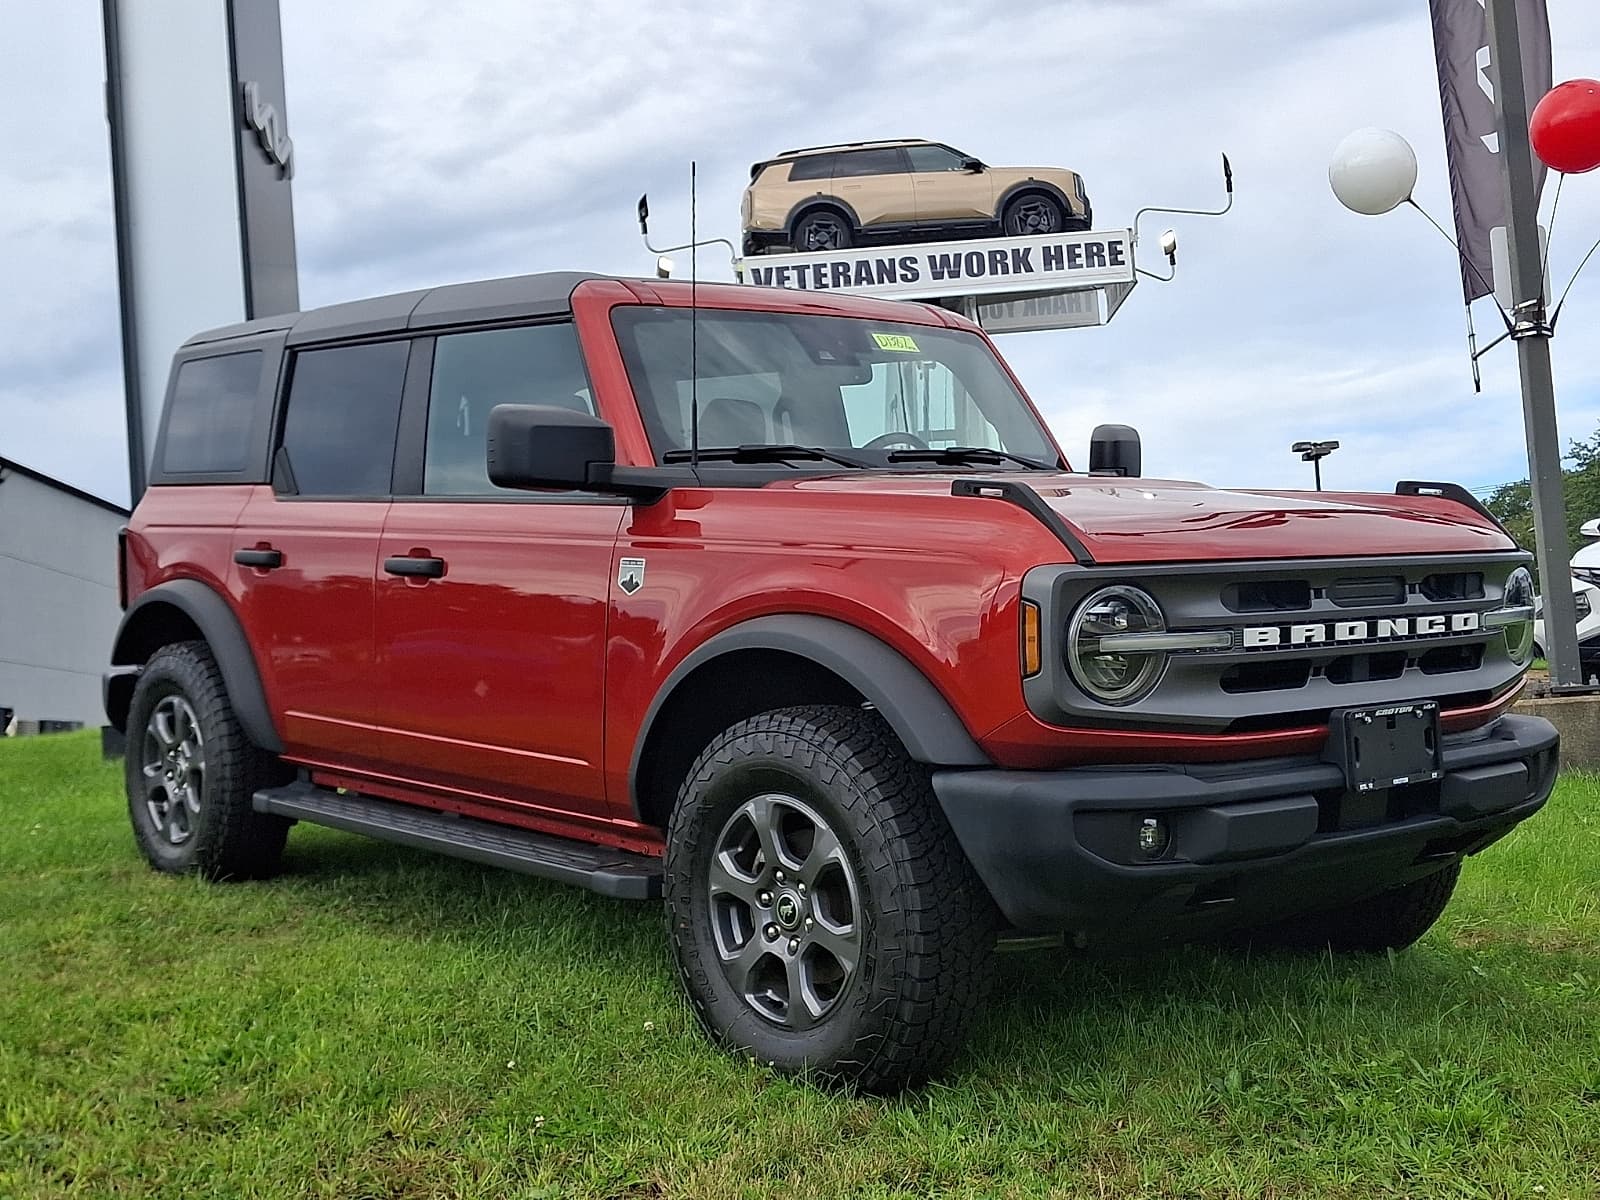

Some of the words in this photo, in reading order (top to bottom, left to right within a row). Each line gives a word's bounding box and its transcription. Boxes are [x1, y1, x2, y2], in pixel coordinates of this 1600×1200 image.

[751, 256, 920, 289] VETERANS
[927, 247, 1034, 281] WORK
[1041, 240, 1126, 272] HERE
[1242, 612, 1480, 648] BRONCO
